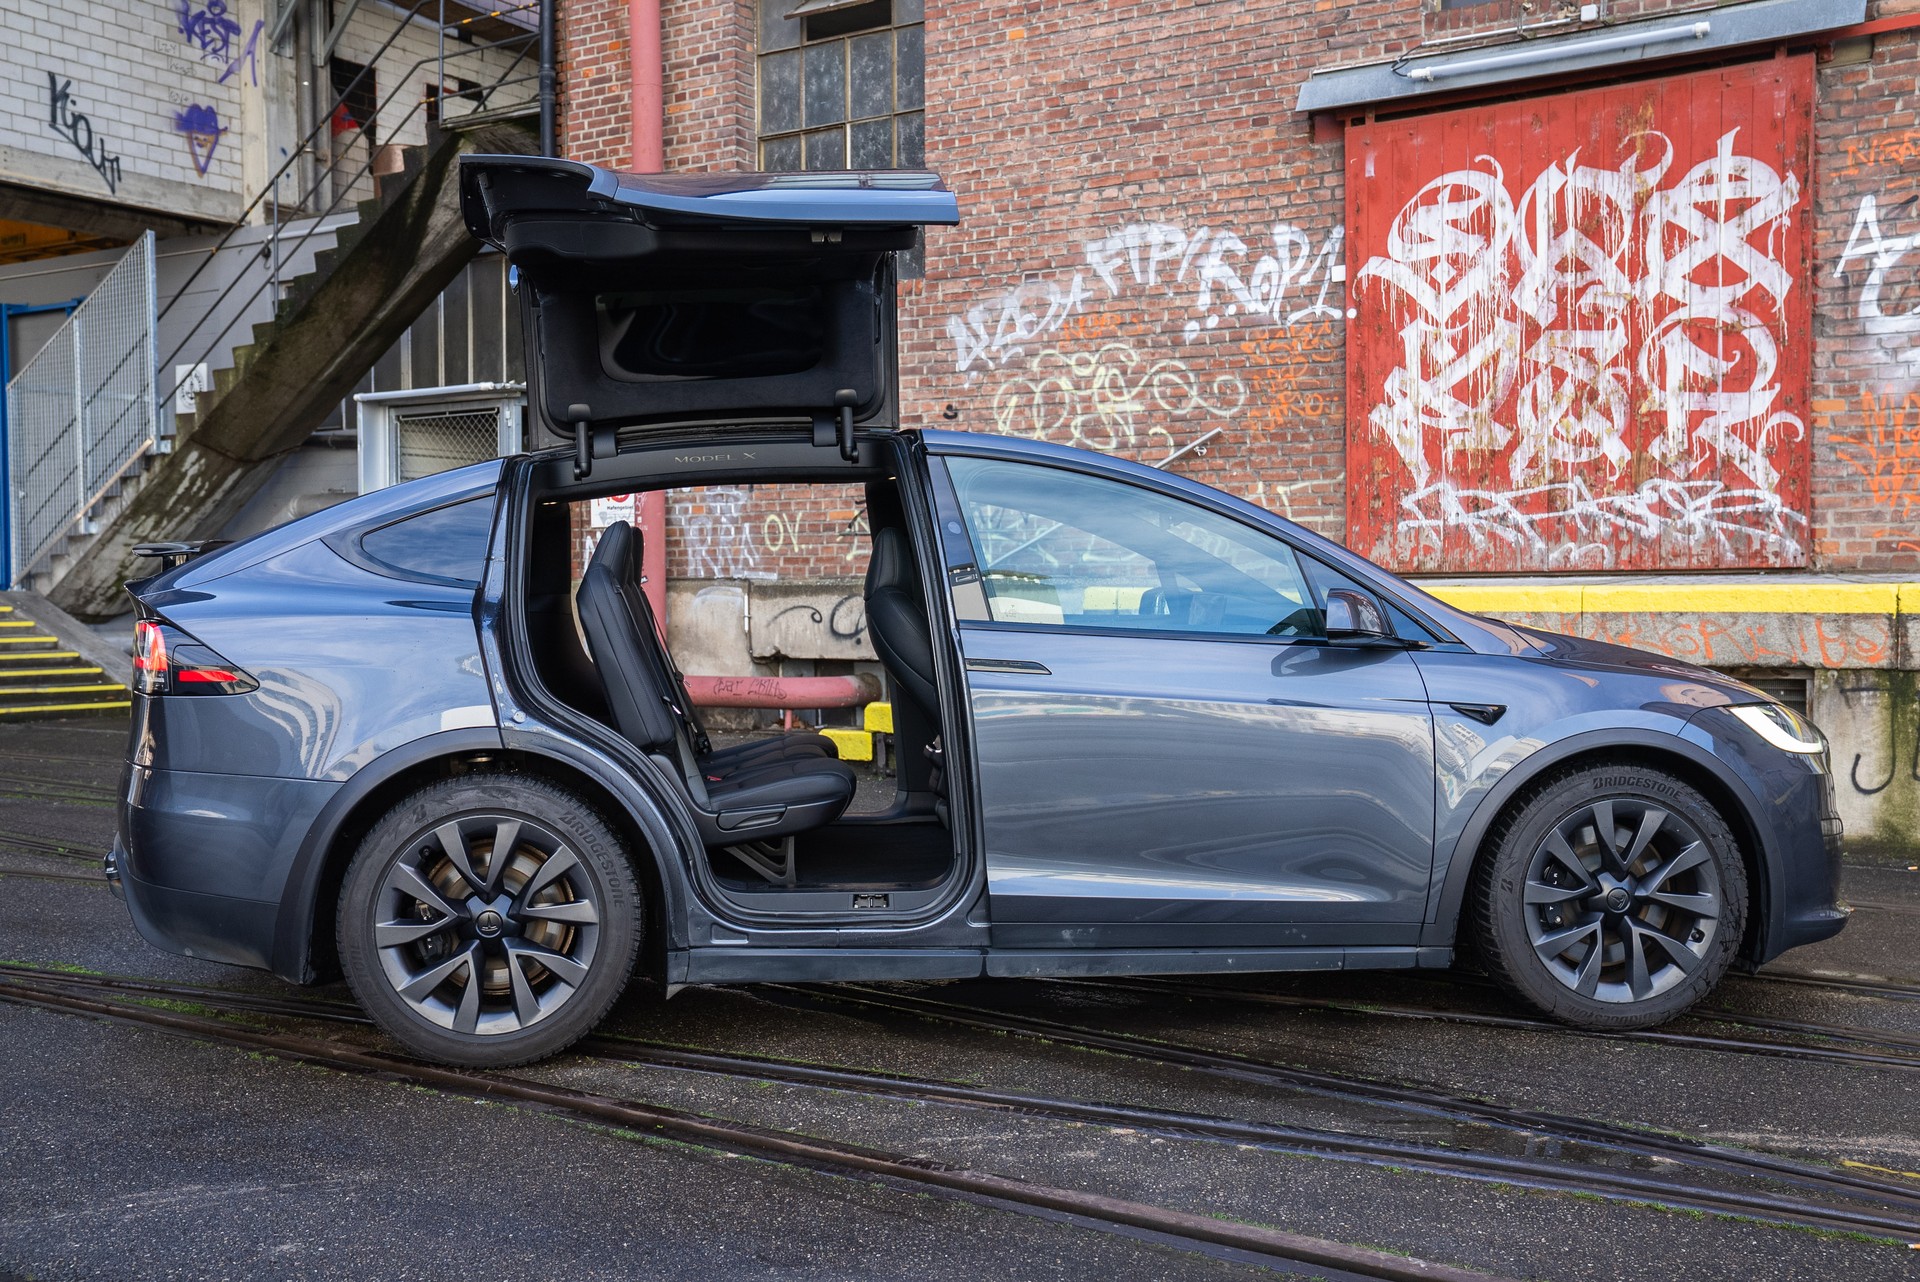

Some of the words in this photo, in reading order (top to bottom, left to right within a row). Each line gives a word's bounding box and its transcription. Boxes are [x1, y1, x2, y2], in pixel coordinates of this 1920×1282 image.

[674, 454, 738, 464] MODEL
[743, 452, 756, 460] X
[1593, 775, 1682, 799] BRIDGESTONE
[559, 810, 626, 909] BRIDGESTONE
